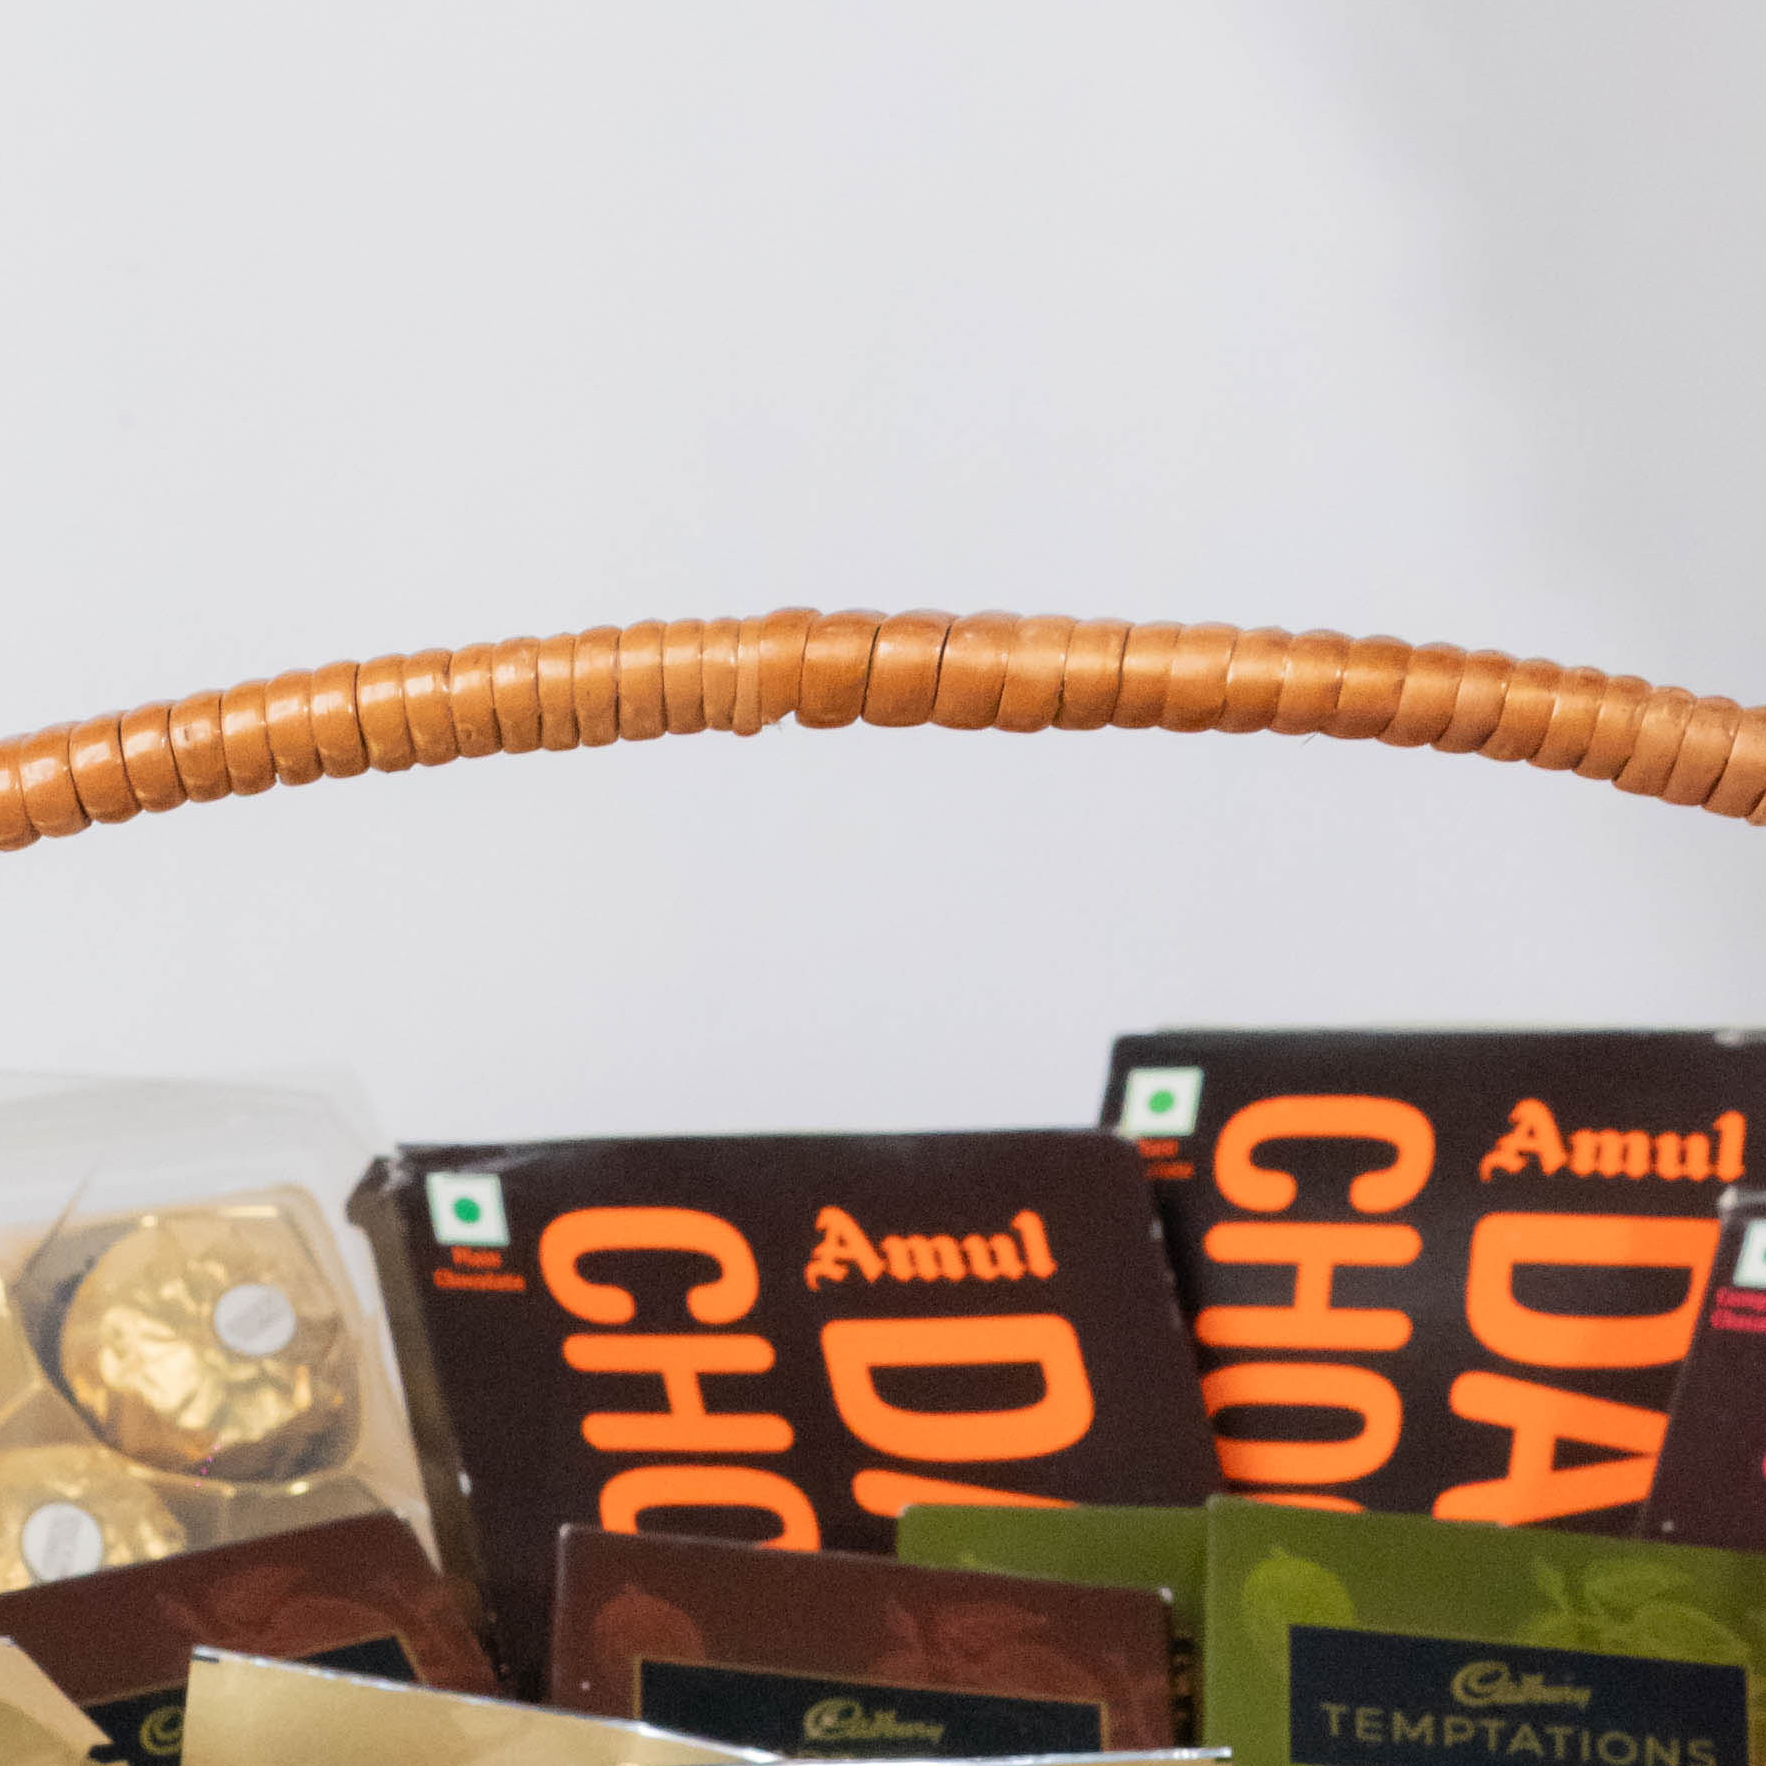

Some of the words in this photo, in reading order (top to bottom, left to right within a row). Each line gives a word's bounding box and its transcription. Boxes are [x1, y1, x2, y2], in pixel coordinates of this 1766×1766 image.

[1479, 1098, 1746, 1183] Amul
[806, 1207, 1056, 1292] Amul
[1195, 1093, 1435, 1514] CHO
